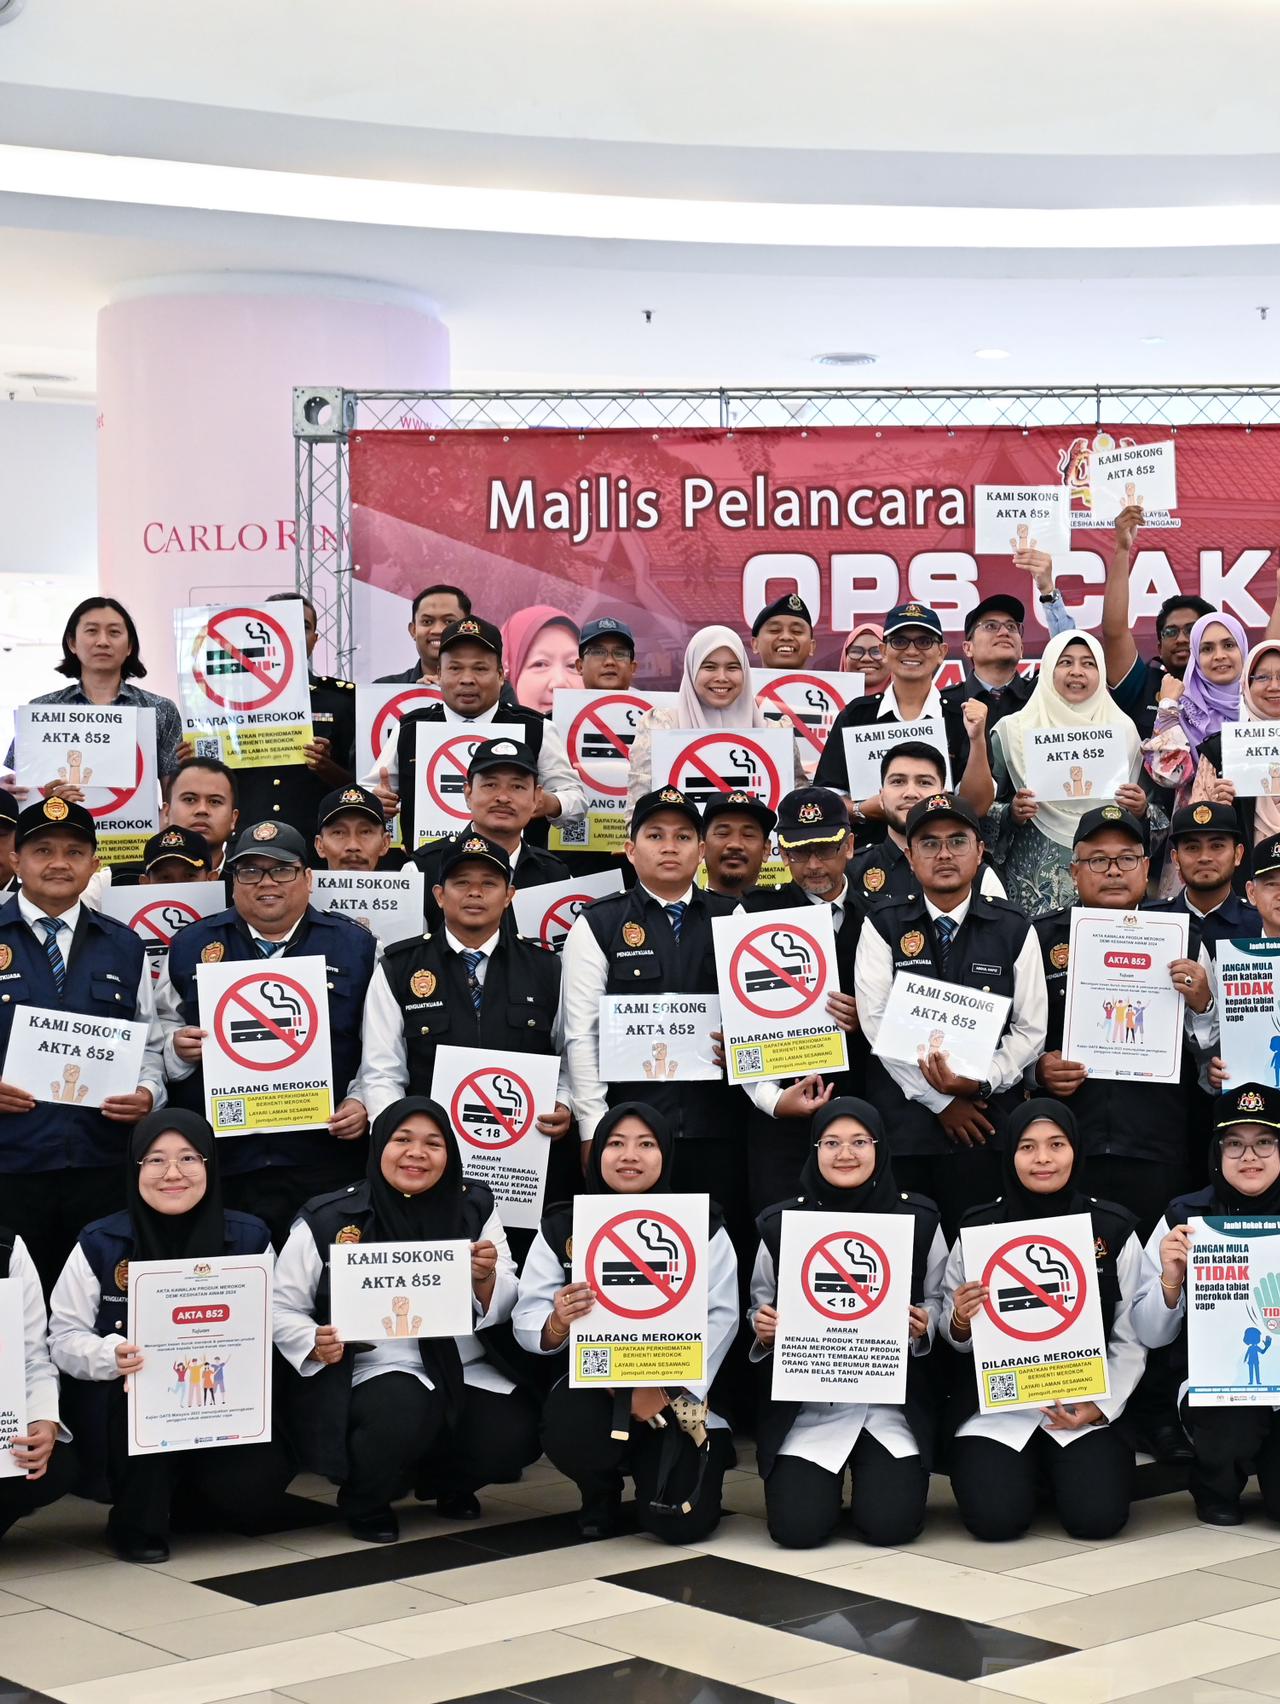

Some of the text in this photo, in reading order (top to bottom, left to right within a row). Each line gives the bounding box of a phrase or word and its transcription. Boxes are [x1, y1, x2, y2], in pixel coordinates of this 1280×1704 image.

[1098, 447, 1162, 465] KAMI SOKONG
[1107, 465, 1155, 480] AKTA 852
[987, 492, 1058, 501] KAMI SOKONG
[490, 475, 967, 542] Majlis Pelancara
[996, 509, 1049, 518] AKTA 852
[1143, 511, 1169, 519] LAYSIA
[1144, 519, 1180, 528] ENGGANU
[143, 522, 268, 554] CARLO
[743, 551, 980, 632] OPS
[31, 712, 122, 723] KAMI SOKONG
[42, 732, 110, 743] AKTA 852
[1034, 730, 1112, 744] KAMI SOKONG
[1046, 748, 1104, 761] AKTA 852
[318, 878, 409, 889] KAMI SOKONG
[329, 898, 397, 912] AKTA 852
[906, 982, 993, 1012] KAMI SOKONG
[615, 1002, 706, 1013] KAMI SOKONG
[910, 1006, 976, 1029] AKTA 852
[29, 1016, 130, 1041] KAMI SOKONG
[626, 1023, 694, 1035] AKTA 852
[38, 1041, 114, 1061] AKTA 852
[1224, 1221, 1241, 1229] Jauhi
[1242, 1221, 1262, 1229] Rokok
[1193, 1244, 1249, 1253] JANGAN MULA
[347, 1250, 453, 1265] KAMI SOKONG
[1193, 1254, 1248, 1264] dan katakan
[1196, 1266, 1248, 1280] TIDAK
[361, 1273, 440, 1288] AKTA 852
[1195, 1282, 1249, 1295] kepada tabiat
[1195, 1291, 1249, 1300] merokok dan
[177, 1309, 223, 1319] AKTA 852
[577, 1333, 701, 1342] DILARANG MEROKOK
[982, 1348, 1101, 1370] DILARANG MEROKOK
